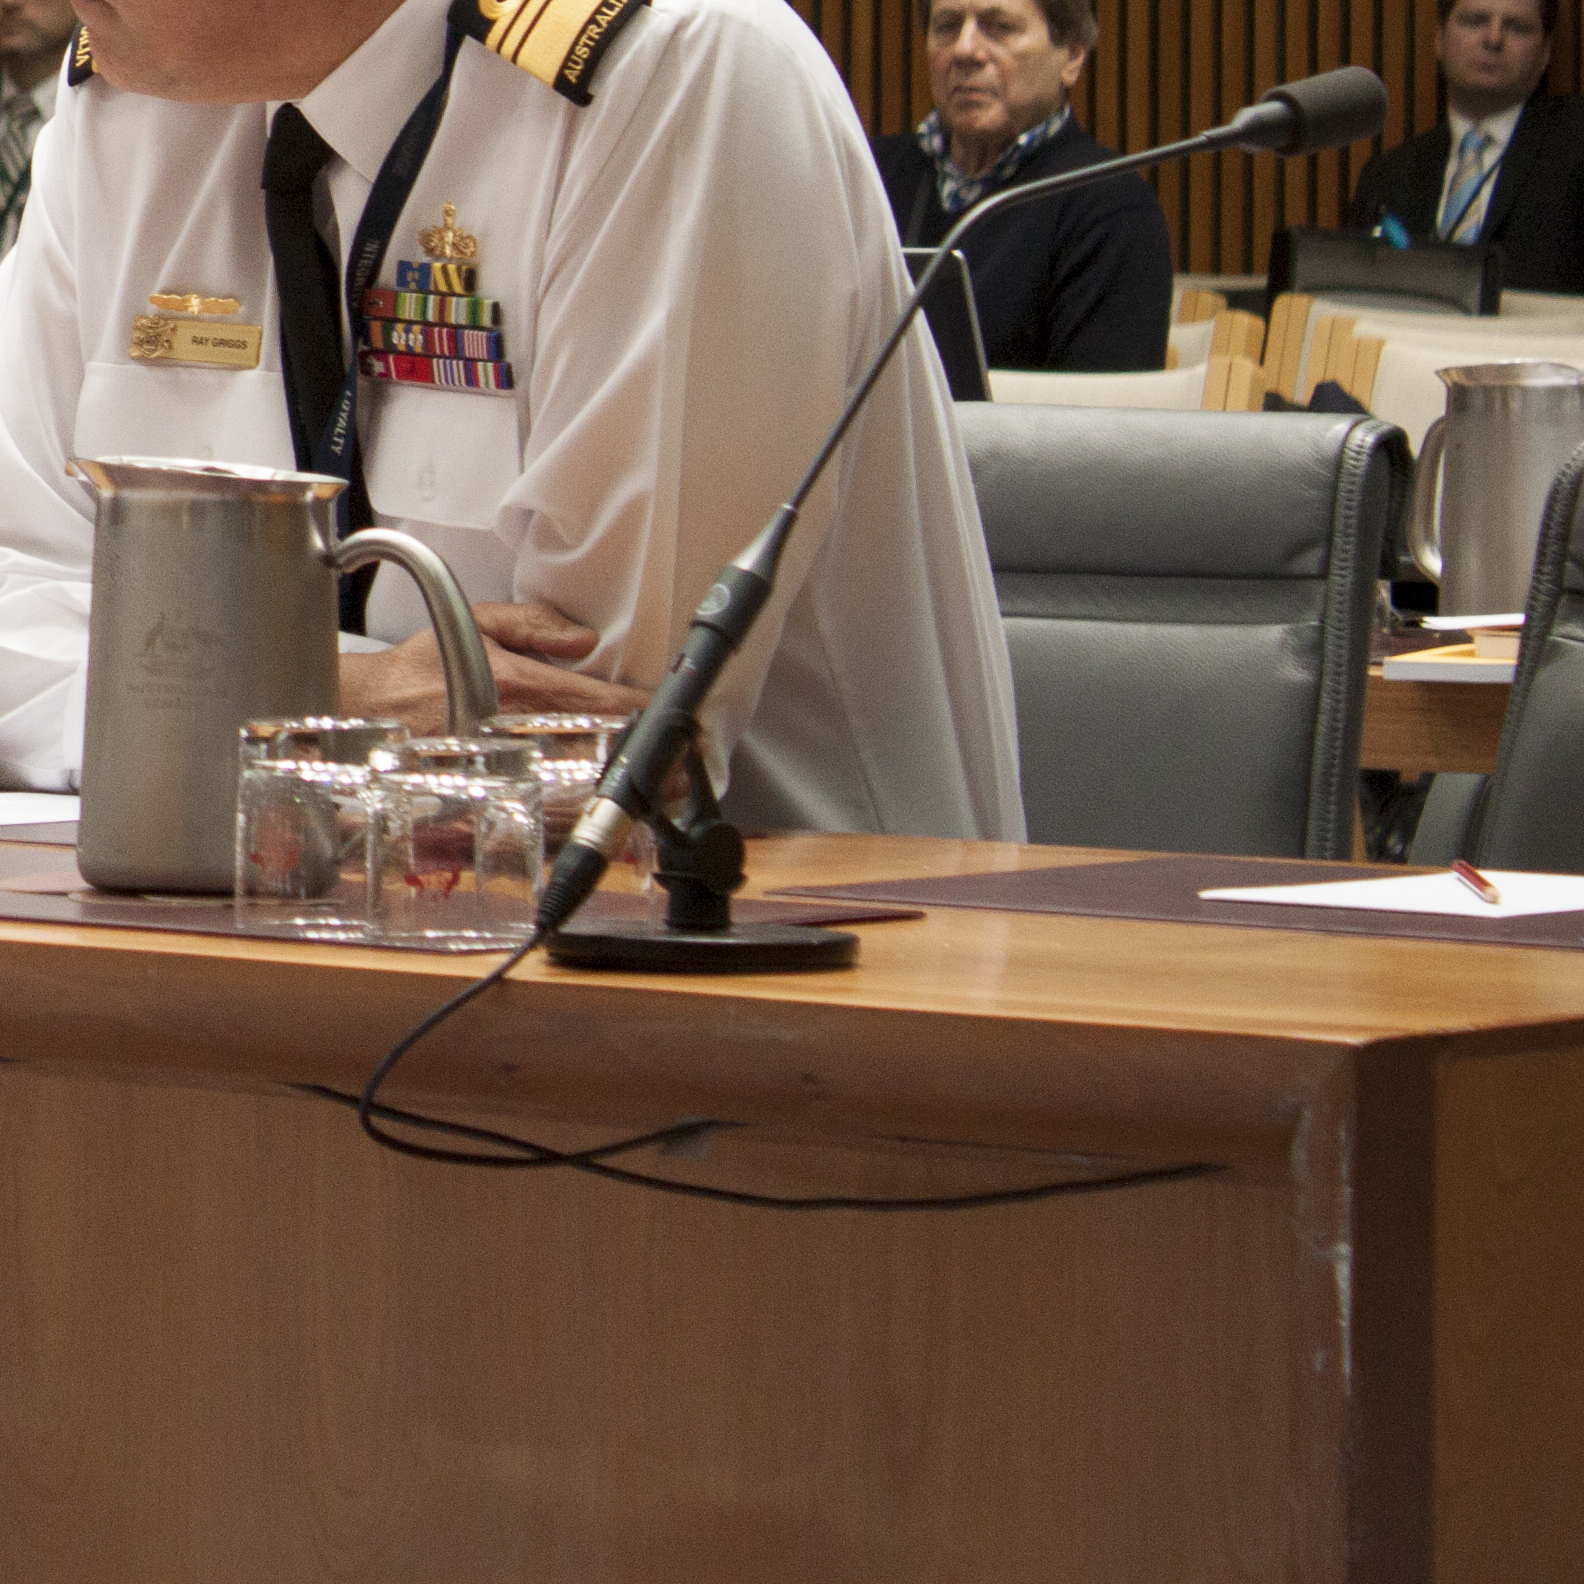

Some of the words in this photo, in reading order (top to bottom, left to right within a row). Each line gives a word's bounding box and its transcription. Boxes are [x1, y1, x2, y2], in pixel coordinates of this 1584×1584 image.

[191, 335, 210, 347] RAY
[211, 337, 249, 350] GRIGGS
[330, 390, 353, 457] LOYALTY
